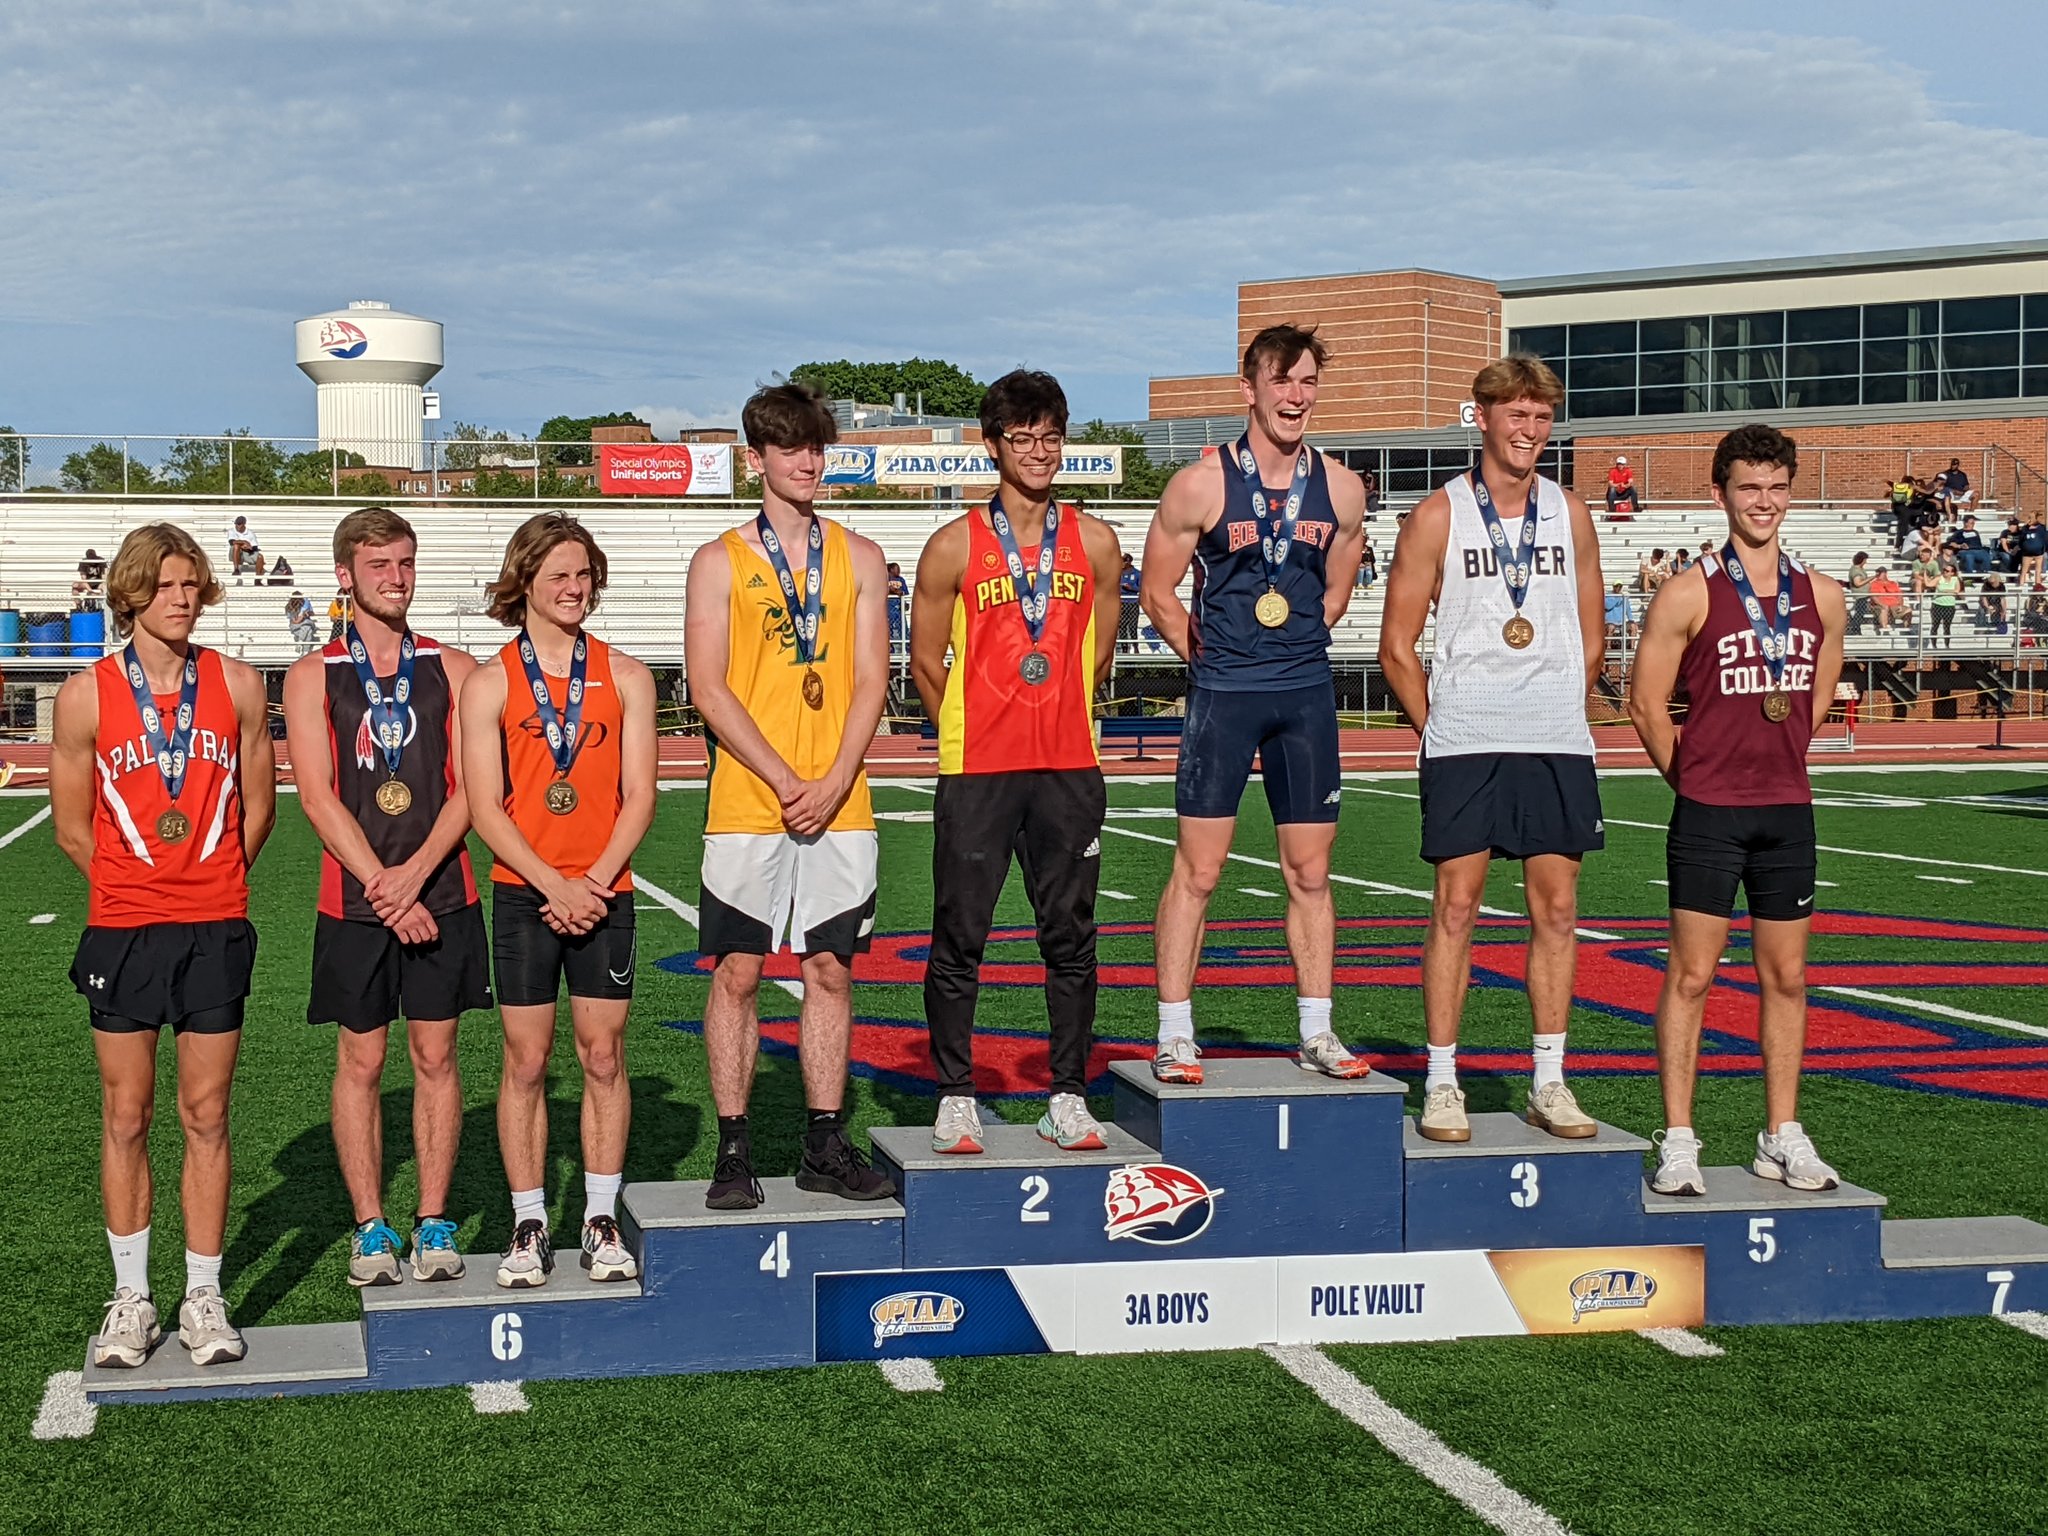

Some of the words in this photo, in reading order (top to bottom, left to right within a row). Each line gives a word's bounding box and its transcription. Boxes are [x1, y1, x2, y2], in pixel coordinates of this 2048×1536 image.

[423, 396, 439, 416] F
[1461, 405, 1476, 424] G
[610, 457, 642, 469] Special
[644, 457, 687, 470] Olympics
[611, 469, 648, 480] Unified
[887, 457, 937, 472] PIAA
[1227, 520, 1333, 553] HEHEY
[1463, 545, 1567, 579] BUER
[976, 571, 1085, 612] PENEST
[1717, 627, 1816, 667] STTE
[1720, 664, 1813, 696] COLLEGE
[109, 728, 231, 781] PALYRA
[1020, 1175, 1050, 1222] 2
[1510, 1162, 1539, 1208] 3
[760, 1231, 790, 1278] 4
[1748, 1217, 1776, 1263] 5
[1311, 1285, 1359, 1317] POLE
[1364, 1283, 1425, 1315] VAULT
[1580, 1273, 1647, 1299] PIAA
[1987, 1270, 2015, 1316] 7
[883, 1298, 956, 1323] PIAA
[1125, 1294, 1151, 1326] 3A
[1156, 1292, 1209, 1324] BOYS
[491, 1312, 523, 1361] 6
